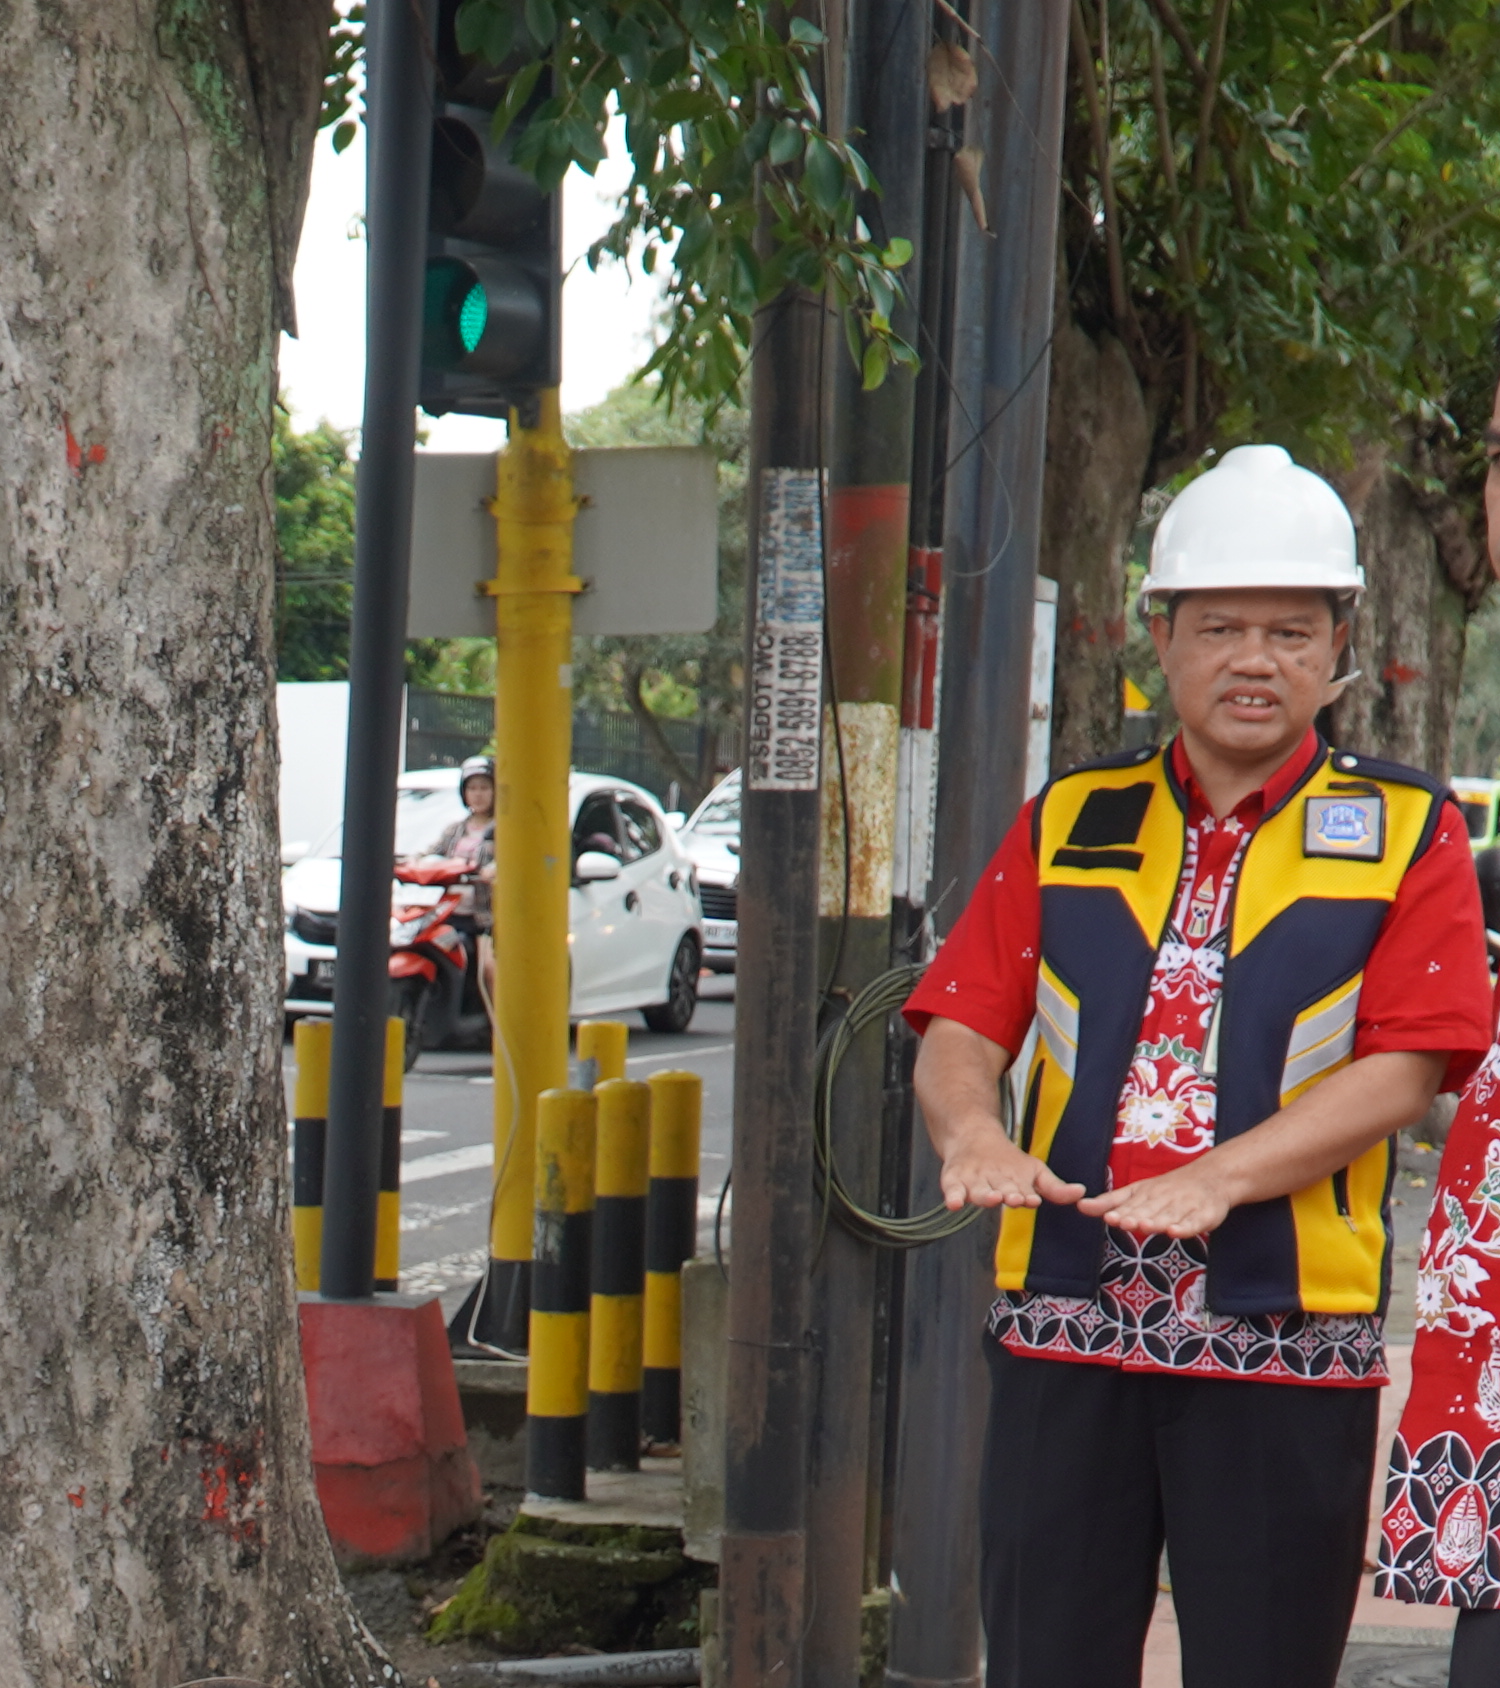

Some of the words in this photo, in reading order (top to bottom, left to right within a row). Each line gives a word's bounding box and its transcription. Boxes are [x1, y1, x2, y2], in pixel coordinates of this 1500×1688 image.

[755, 633, 774, 672] WC
[752, 679, 772, 758] SEDOT
[774, 737, 816, 781] 0852
